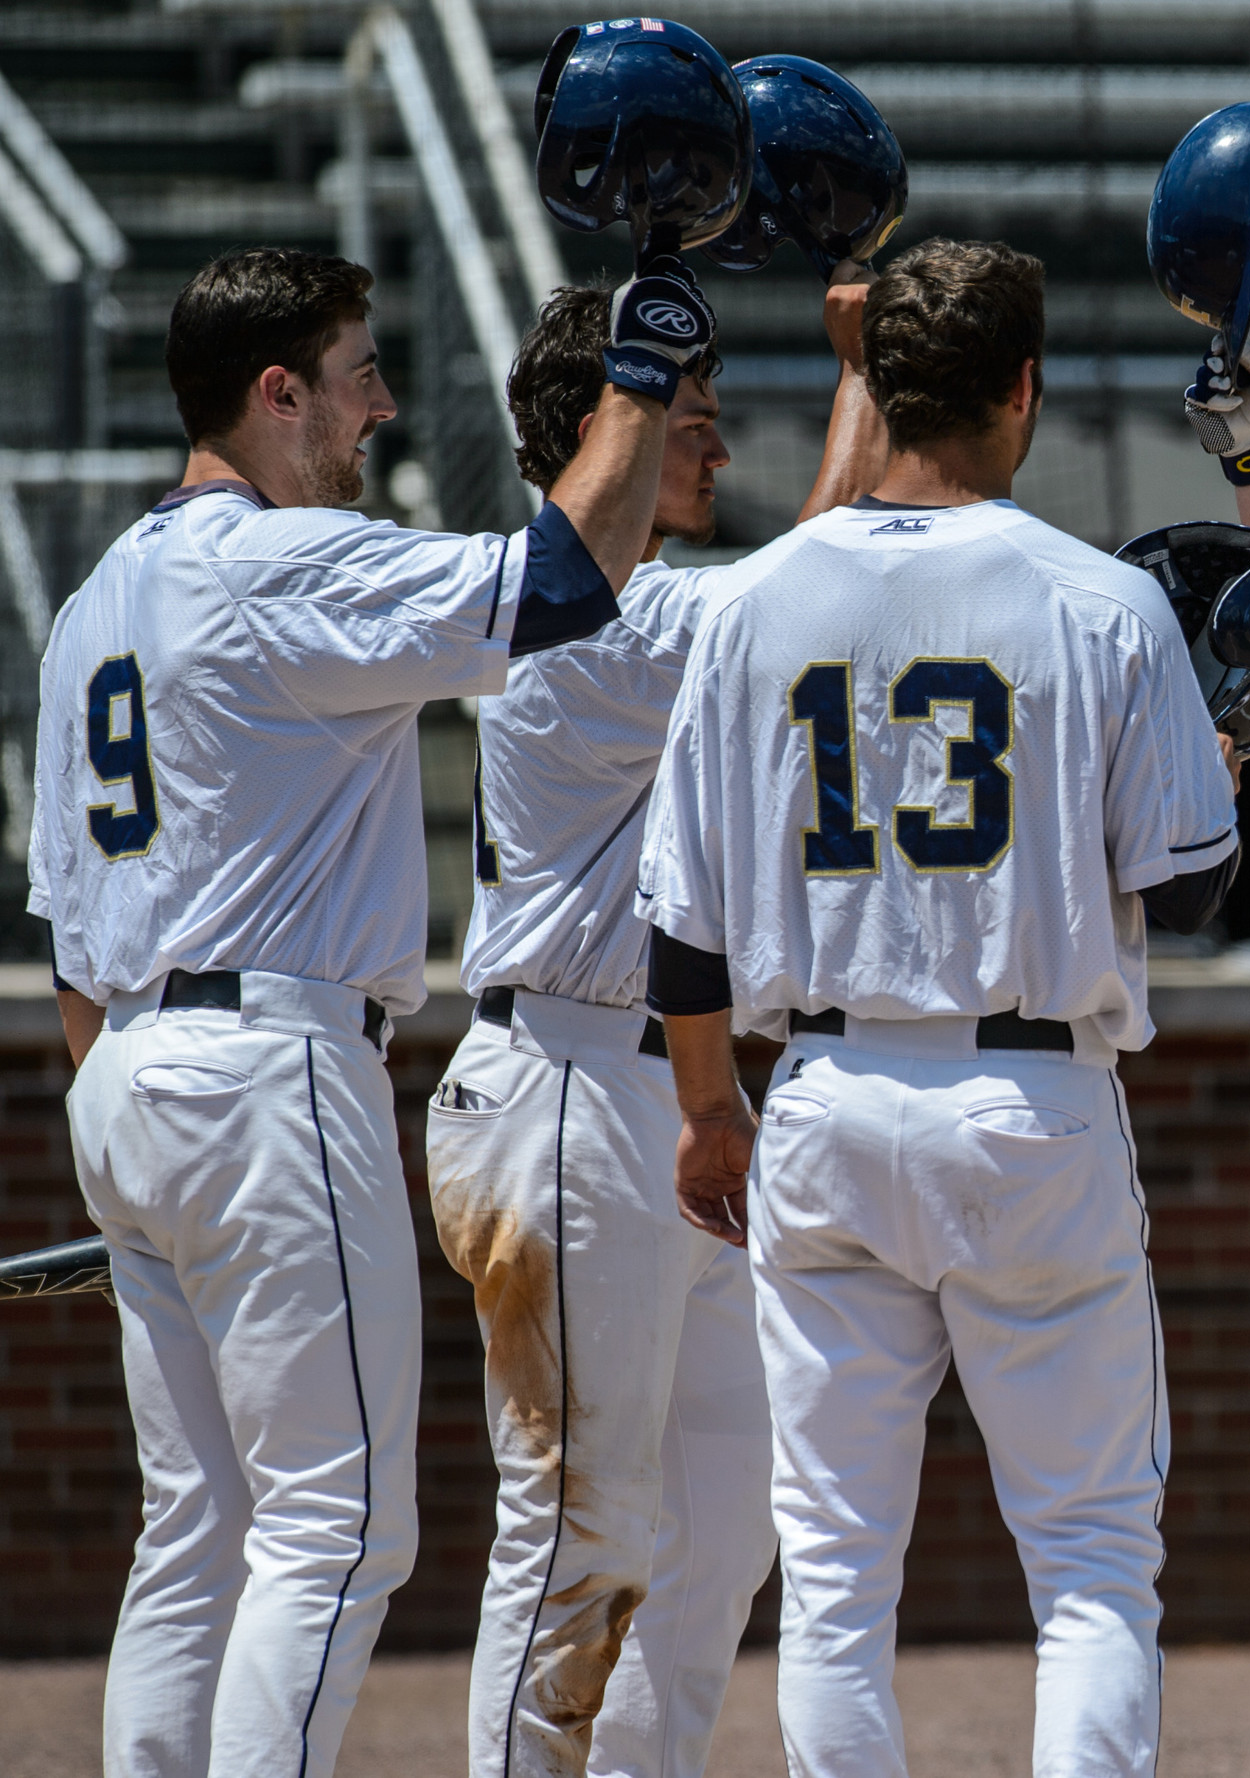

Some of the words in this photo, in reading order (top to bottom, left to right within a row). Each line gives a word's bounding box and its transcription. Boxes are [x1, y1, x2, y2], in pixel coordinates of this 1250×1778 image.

[644, 306, 689, 333] R
[615, 360, 668, 386] Rawlings
[873, 516, 934, 532] ACC
[86, 649, 162, 863] 9
[787, 655, 1015, 877] 13
